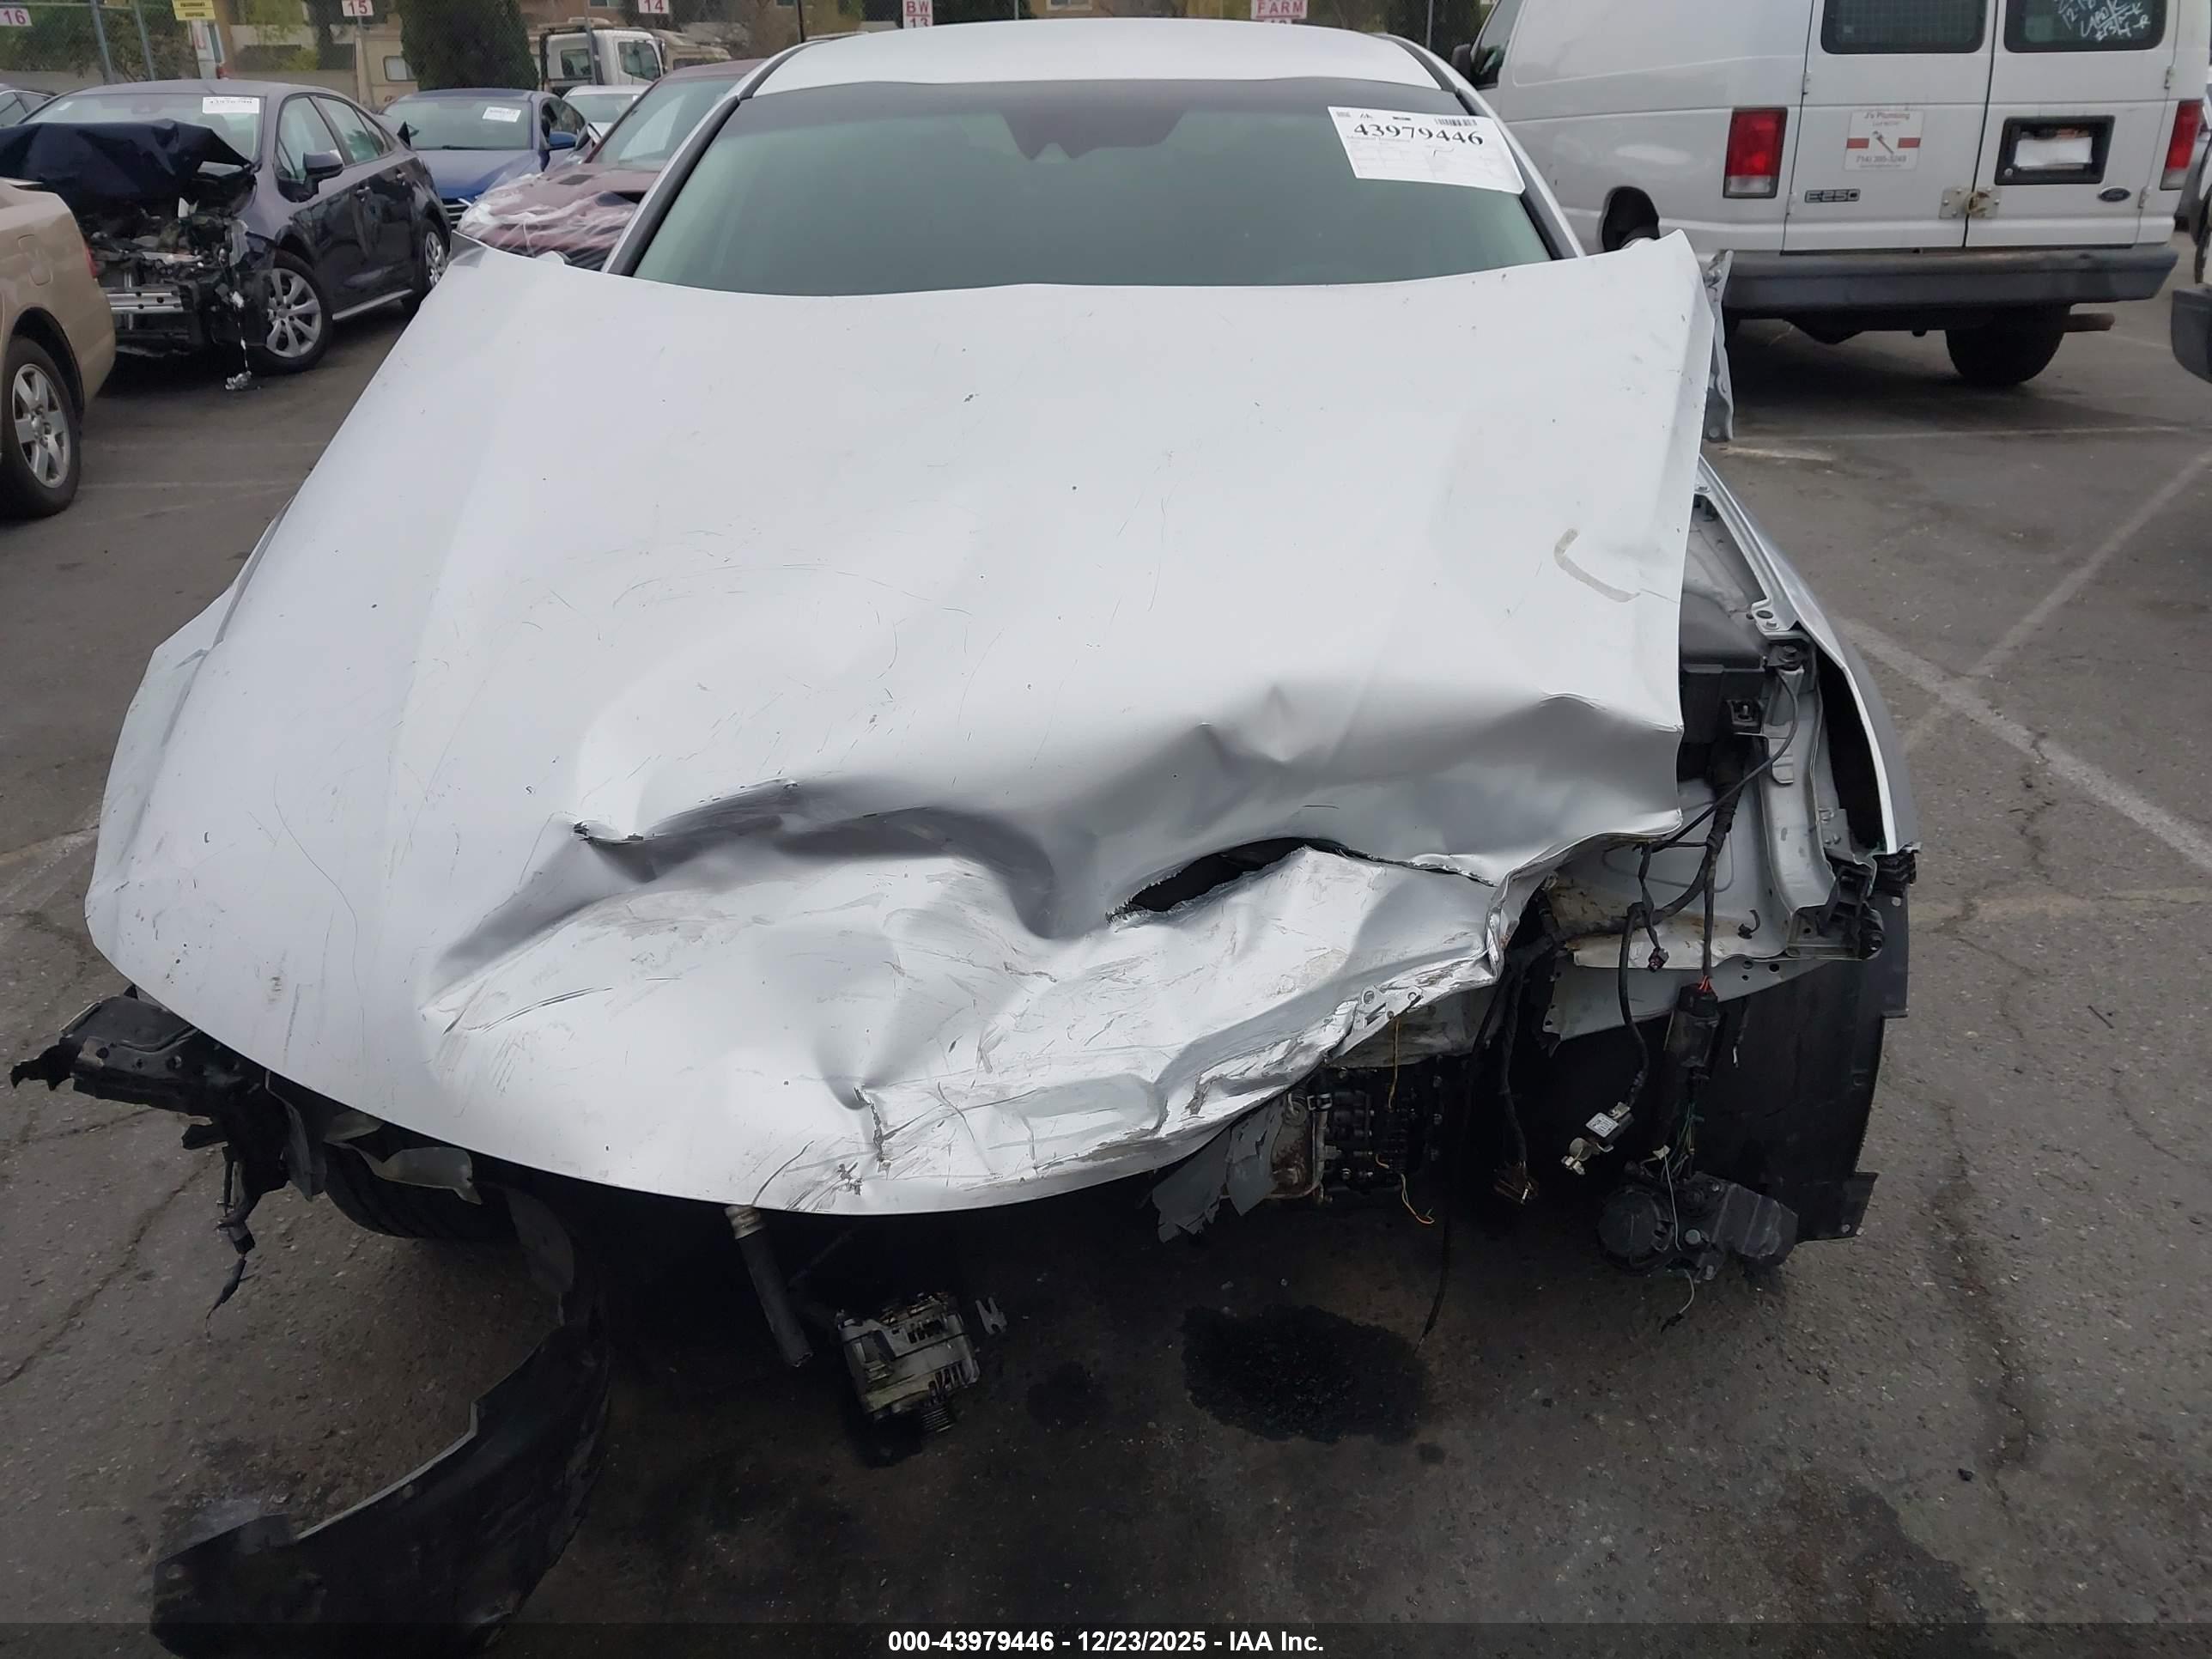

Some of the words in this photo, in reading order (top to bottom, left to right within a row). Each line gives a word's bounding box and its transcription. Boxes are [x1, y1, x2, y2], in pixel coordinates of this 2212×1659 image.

[348, 0, 368, 15] 15
[644, 0, 664, 14] 14
[906, 1, 929, 15] BW
[1257, 0, 1304, 15] FARM
[3, 9, 26, 25] 16
[1353, 123, 1485, 145] 43979446
